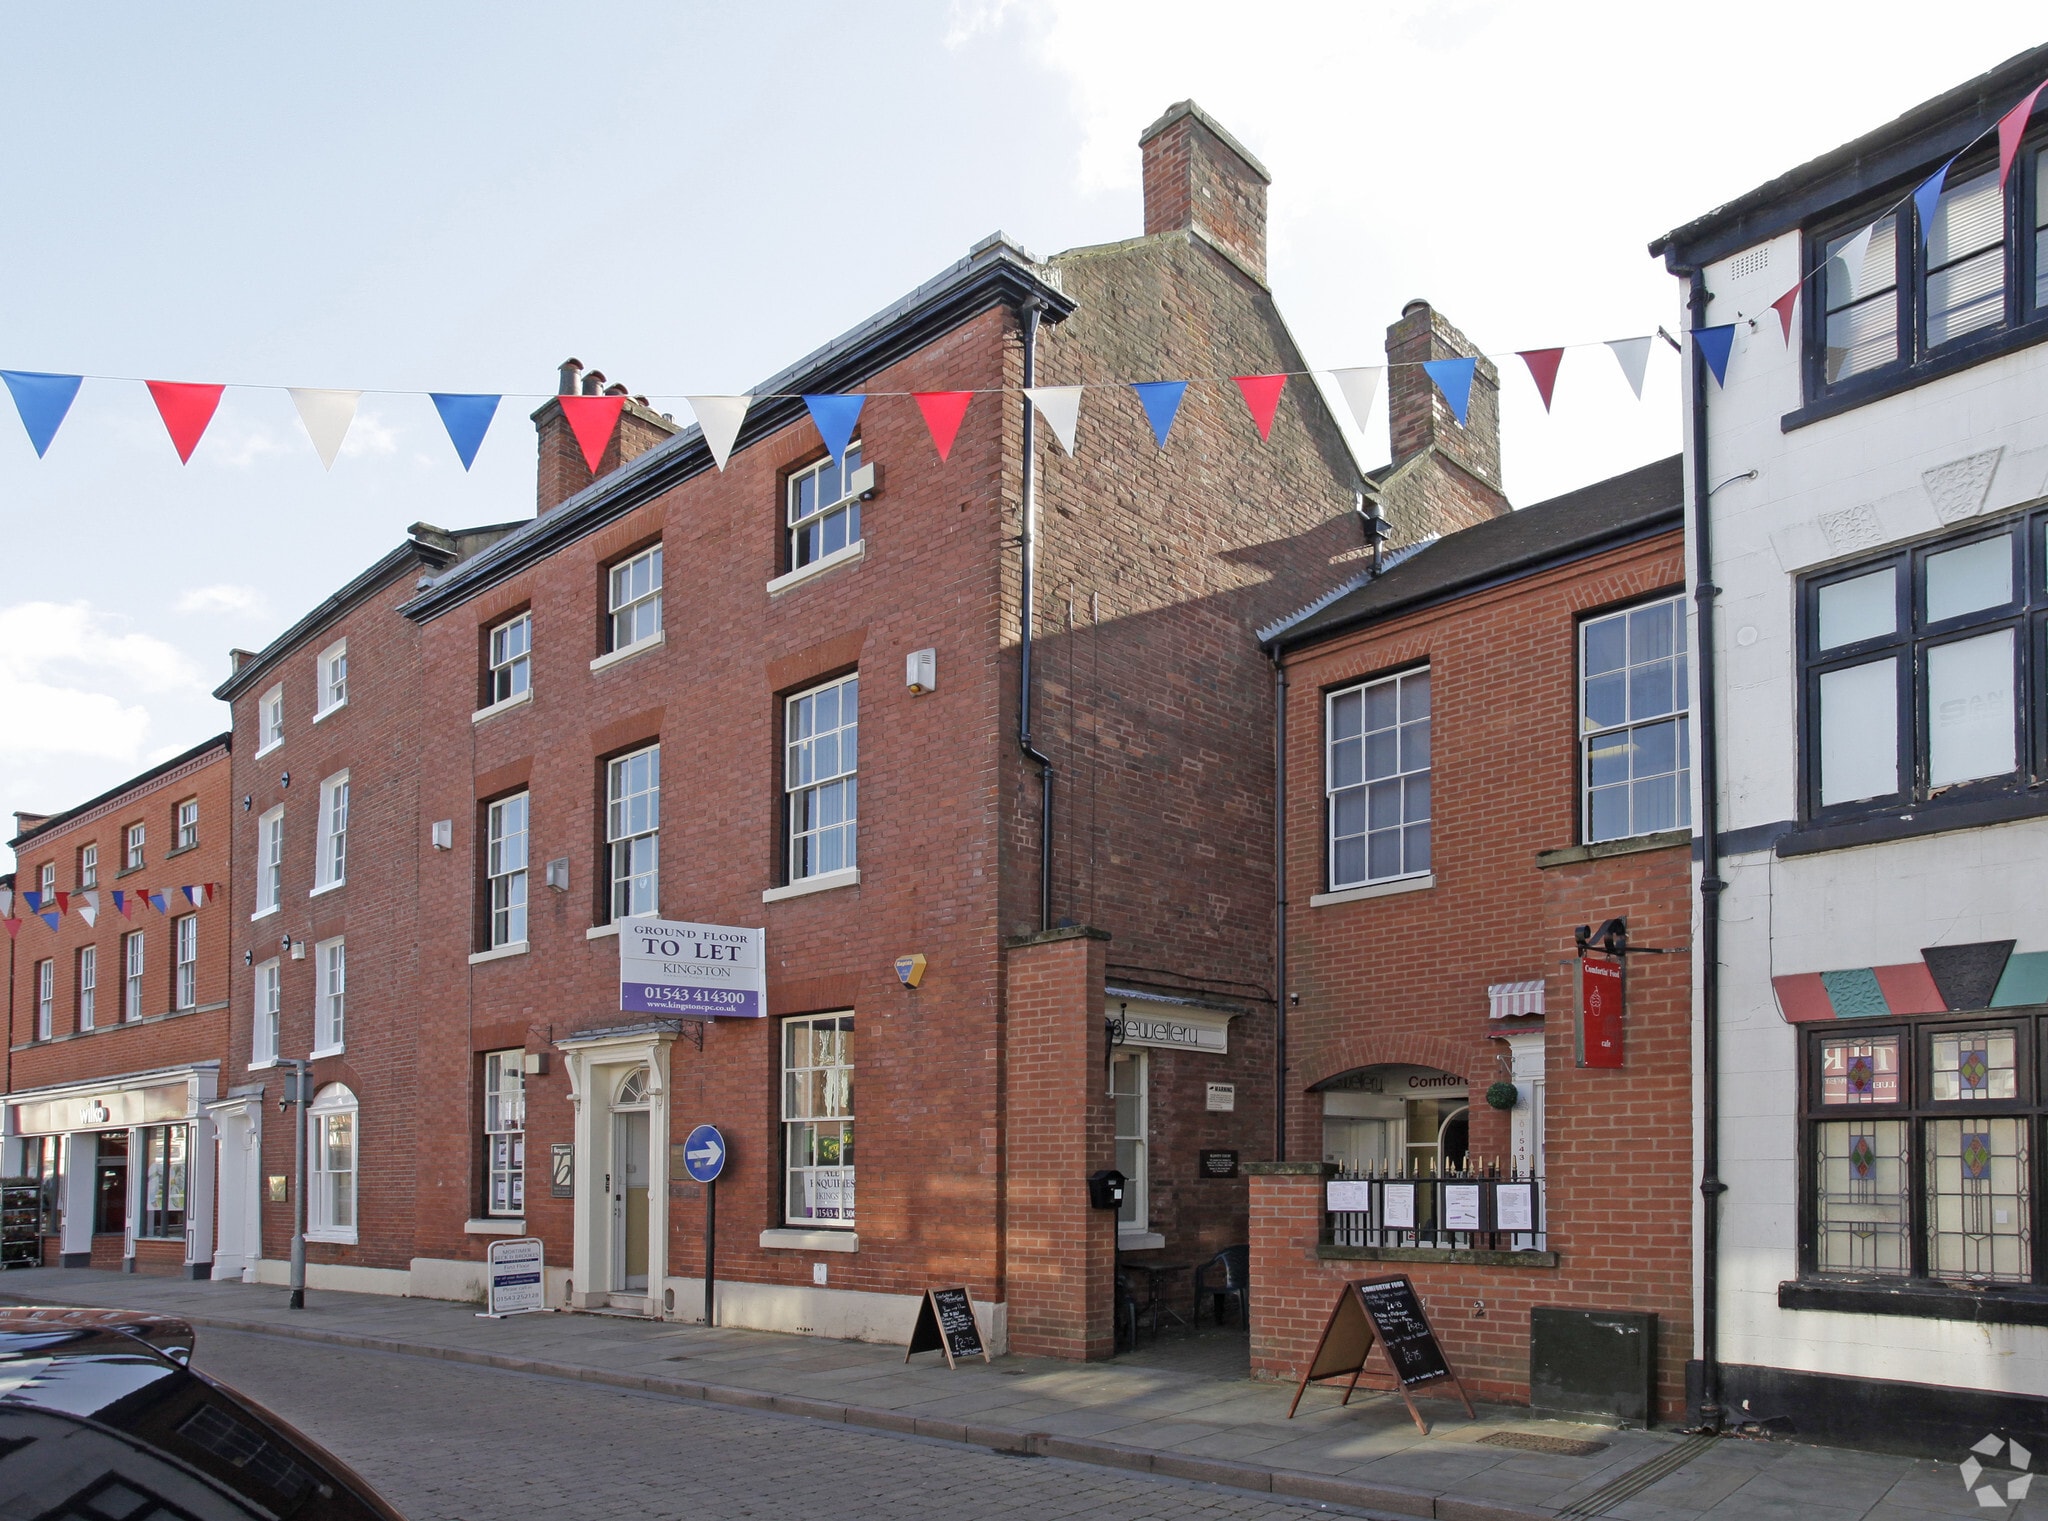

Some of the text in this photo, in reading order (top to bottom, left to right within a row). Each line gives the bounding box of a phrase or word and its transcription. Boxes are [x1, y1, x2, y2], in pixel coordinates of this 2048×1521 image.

[634, 925, 748, 944] GROUND FLOOR
[642, 938, 742, 962] TO LET
[663, 962, 731, 977] KINGSTON
[644, 986, 745, 1004] 01543 414300
[646, 1001, 737, 1012] www.kingstoncpc.co.uk
[1408, 1073, 1469, 1089] Comfort
[80, 1099, 108, 1124] wilko
[816, 1192, 853, 1201] KINGSON
[496, 1294, 516, 1302] 01543
